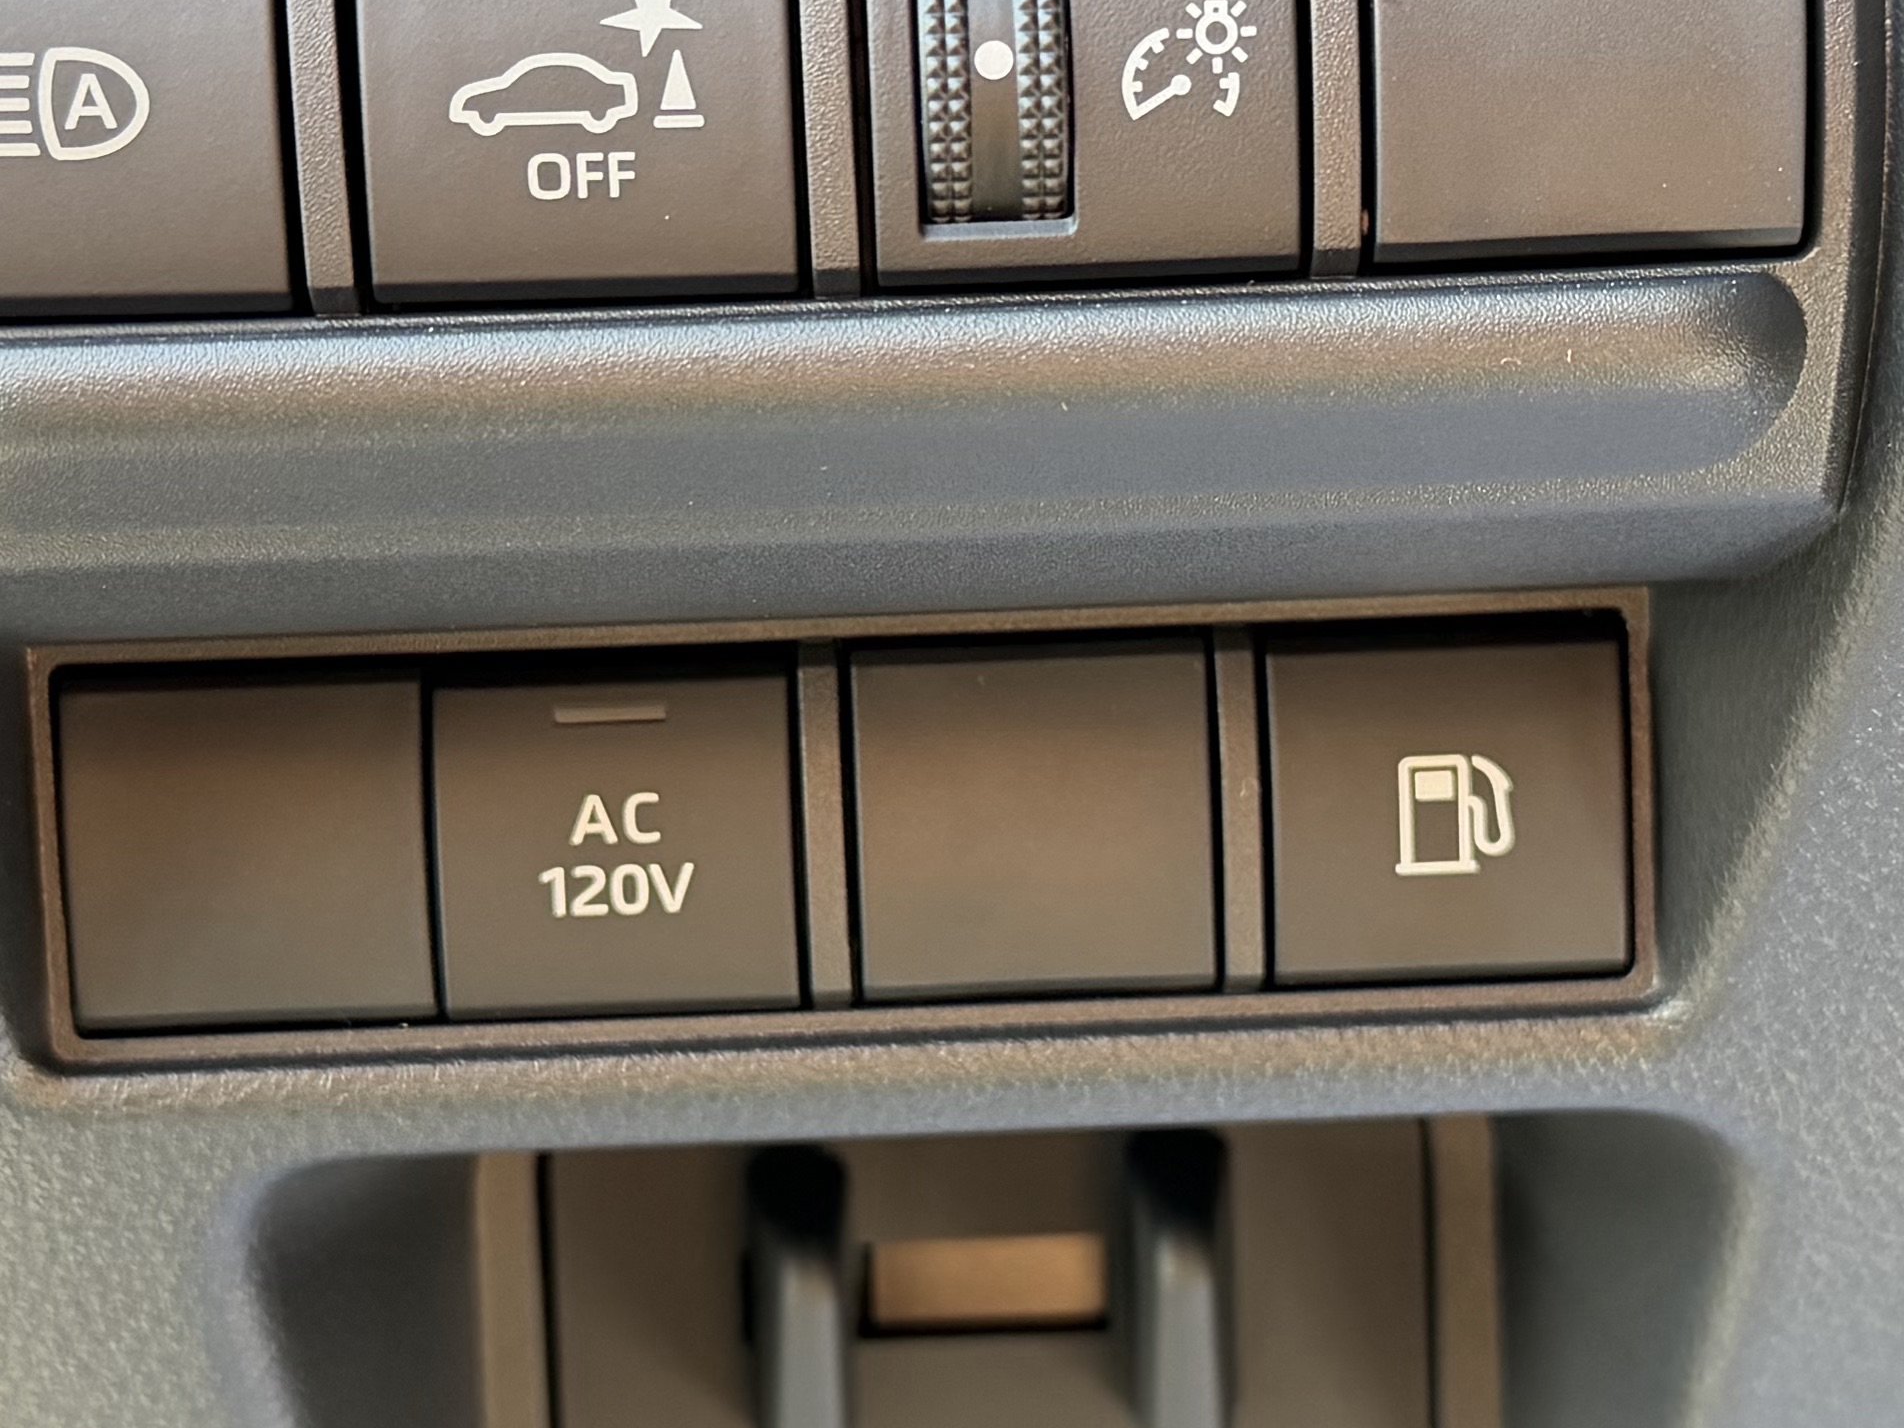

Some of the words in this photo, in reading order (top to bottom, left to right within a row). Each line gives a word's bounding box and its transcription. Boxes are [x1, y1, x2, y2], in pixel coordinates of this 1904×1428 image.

[63, 72, 117, 131] A
[526, 151, 636, 200] OFF
[568, 791, 662, 846] AC
[537, 861, 695, 918] 120V
